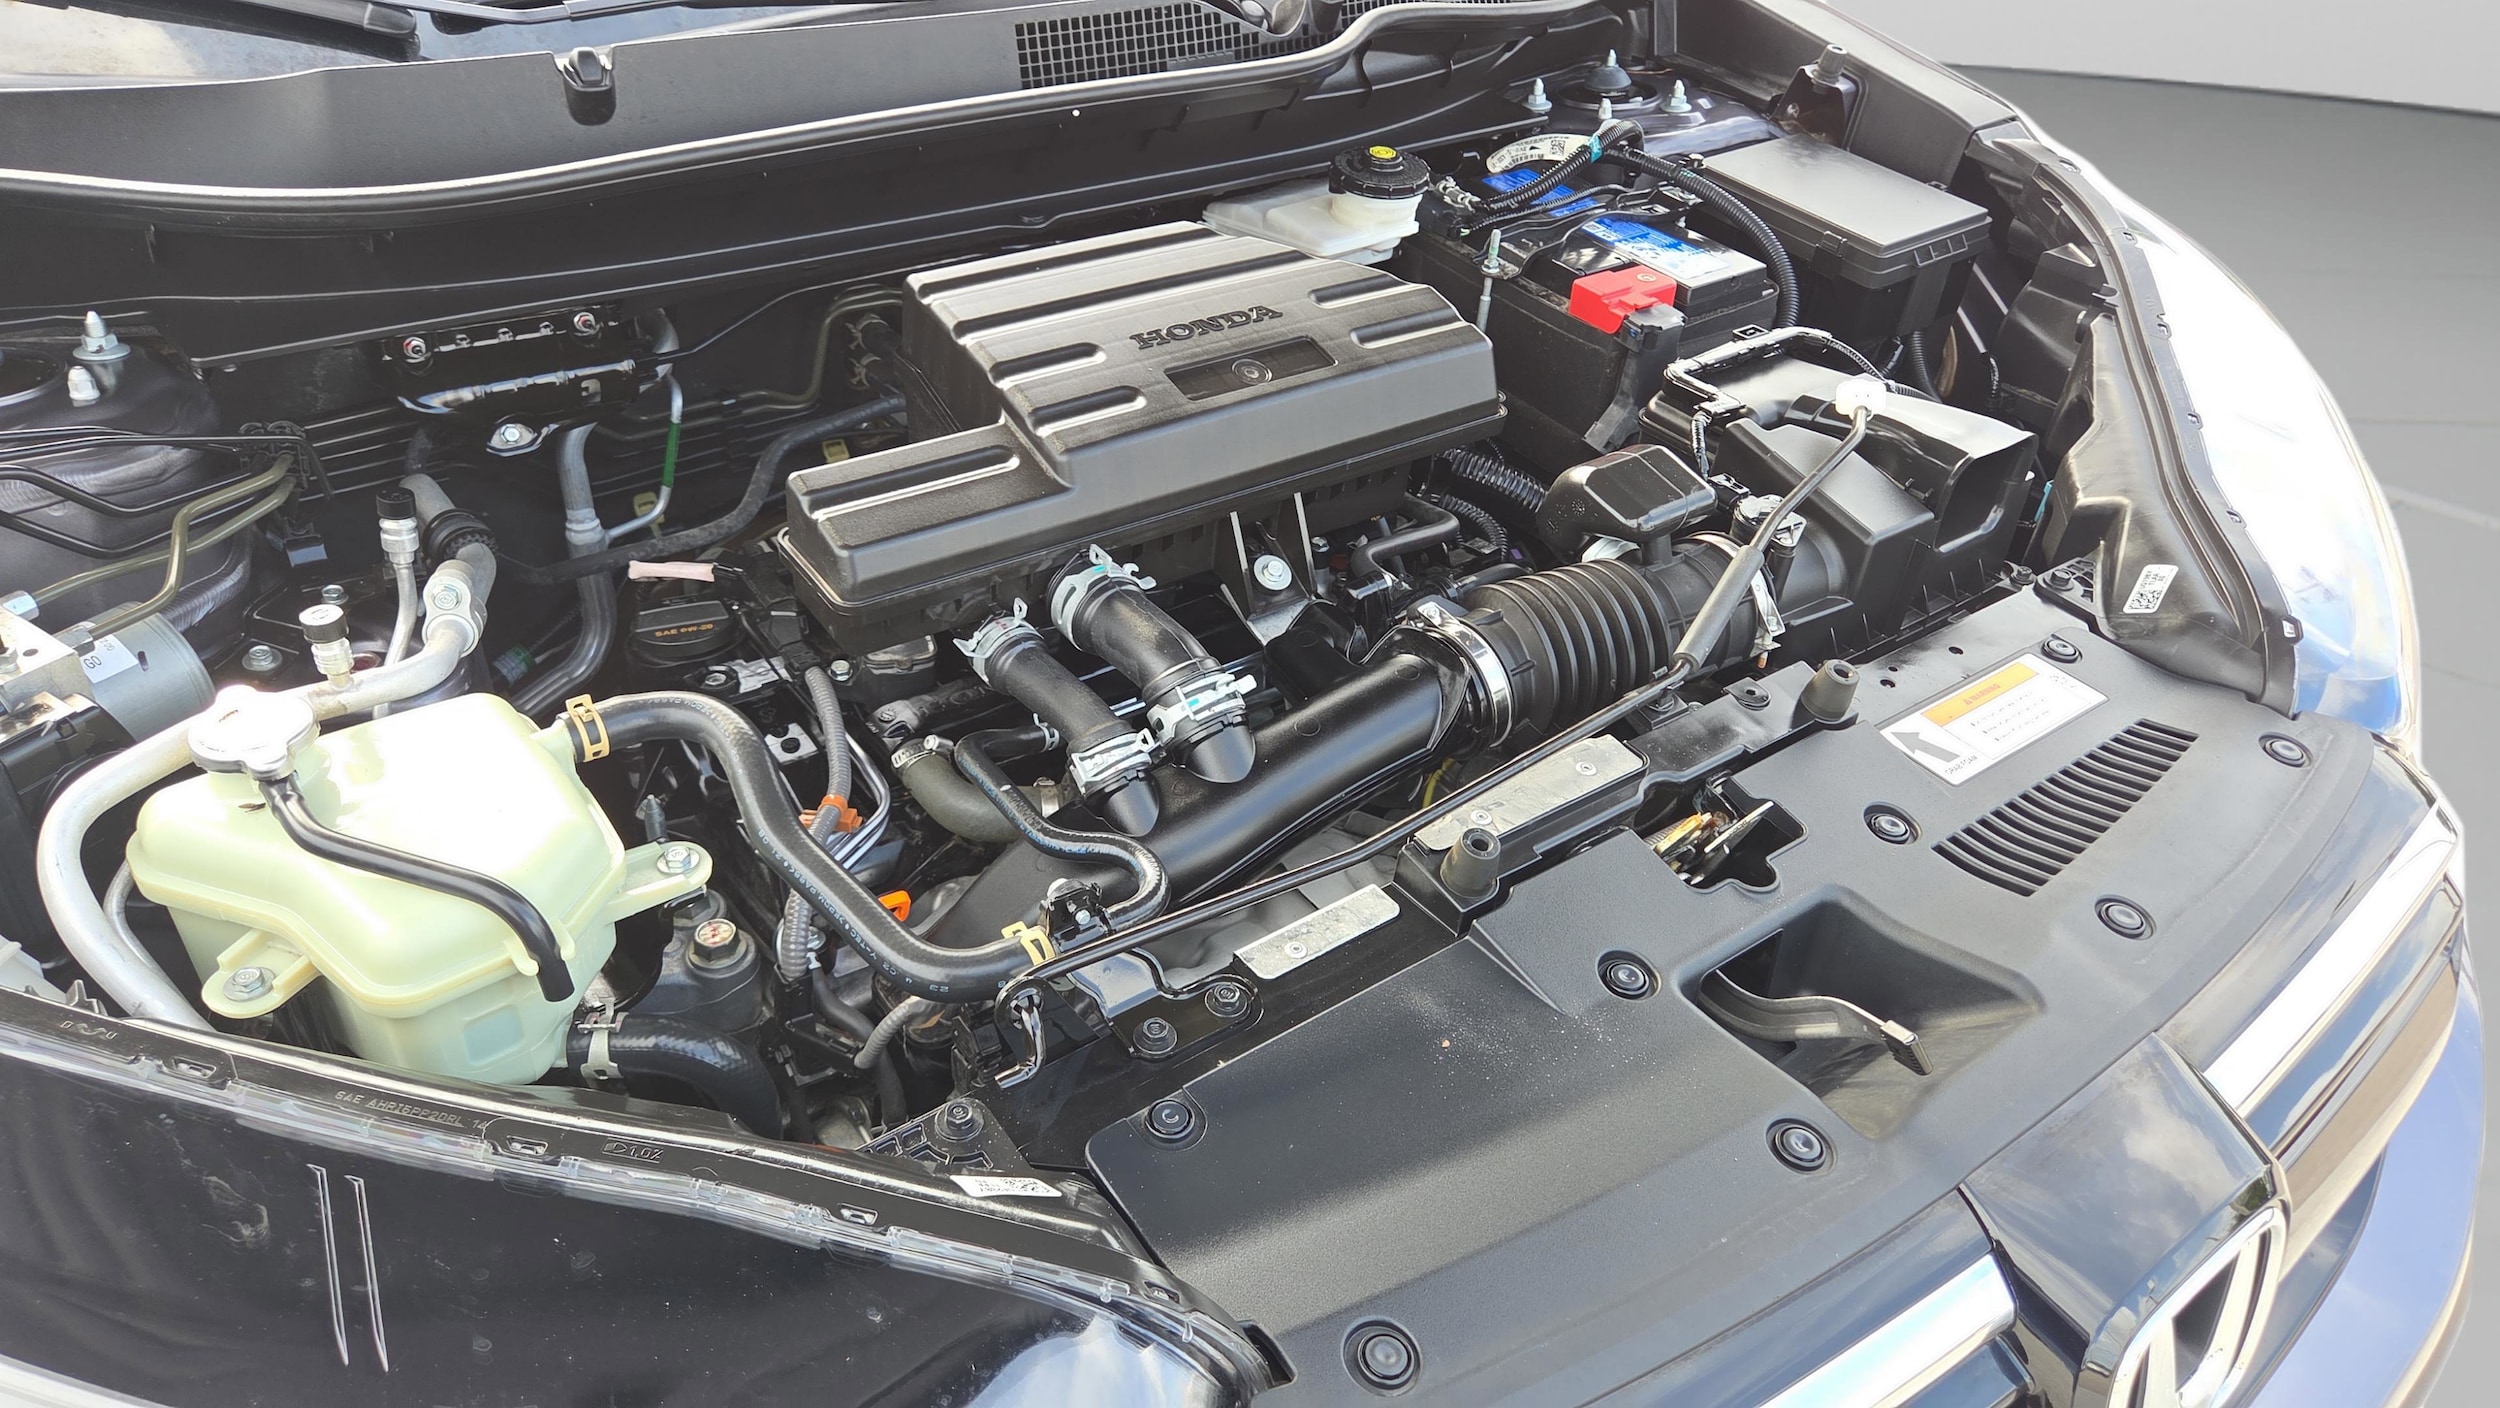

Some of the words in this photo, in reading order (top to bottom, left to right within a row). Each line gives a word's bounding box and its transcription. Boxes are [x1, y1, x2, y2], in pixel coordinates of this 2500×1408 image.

[1129, 305, 1283, 349] HONDA
[654, 628, 678, 638] SAE
[680, 623, 714, 633] 0W-20
[83, 655, 102, 669] GO
[1969, 683, 2001, 705] WARNING
[334, 1091, 365, 1104] SAE
